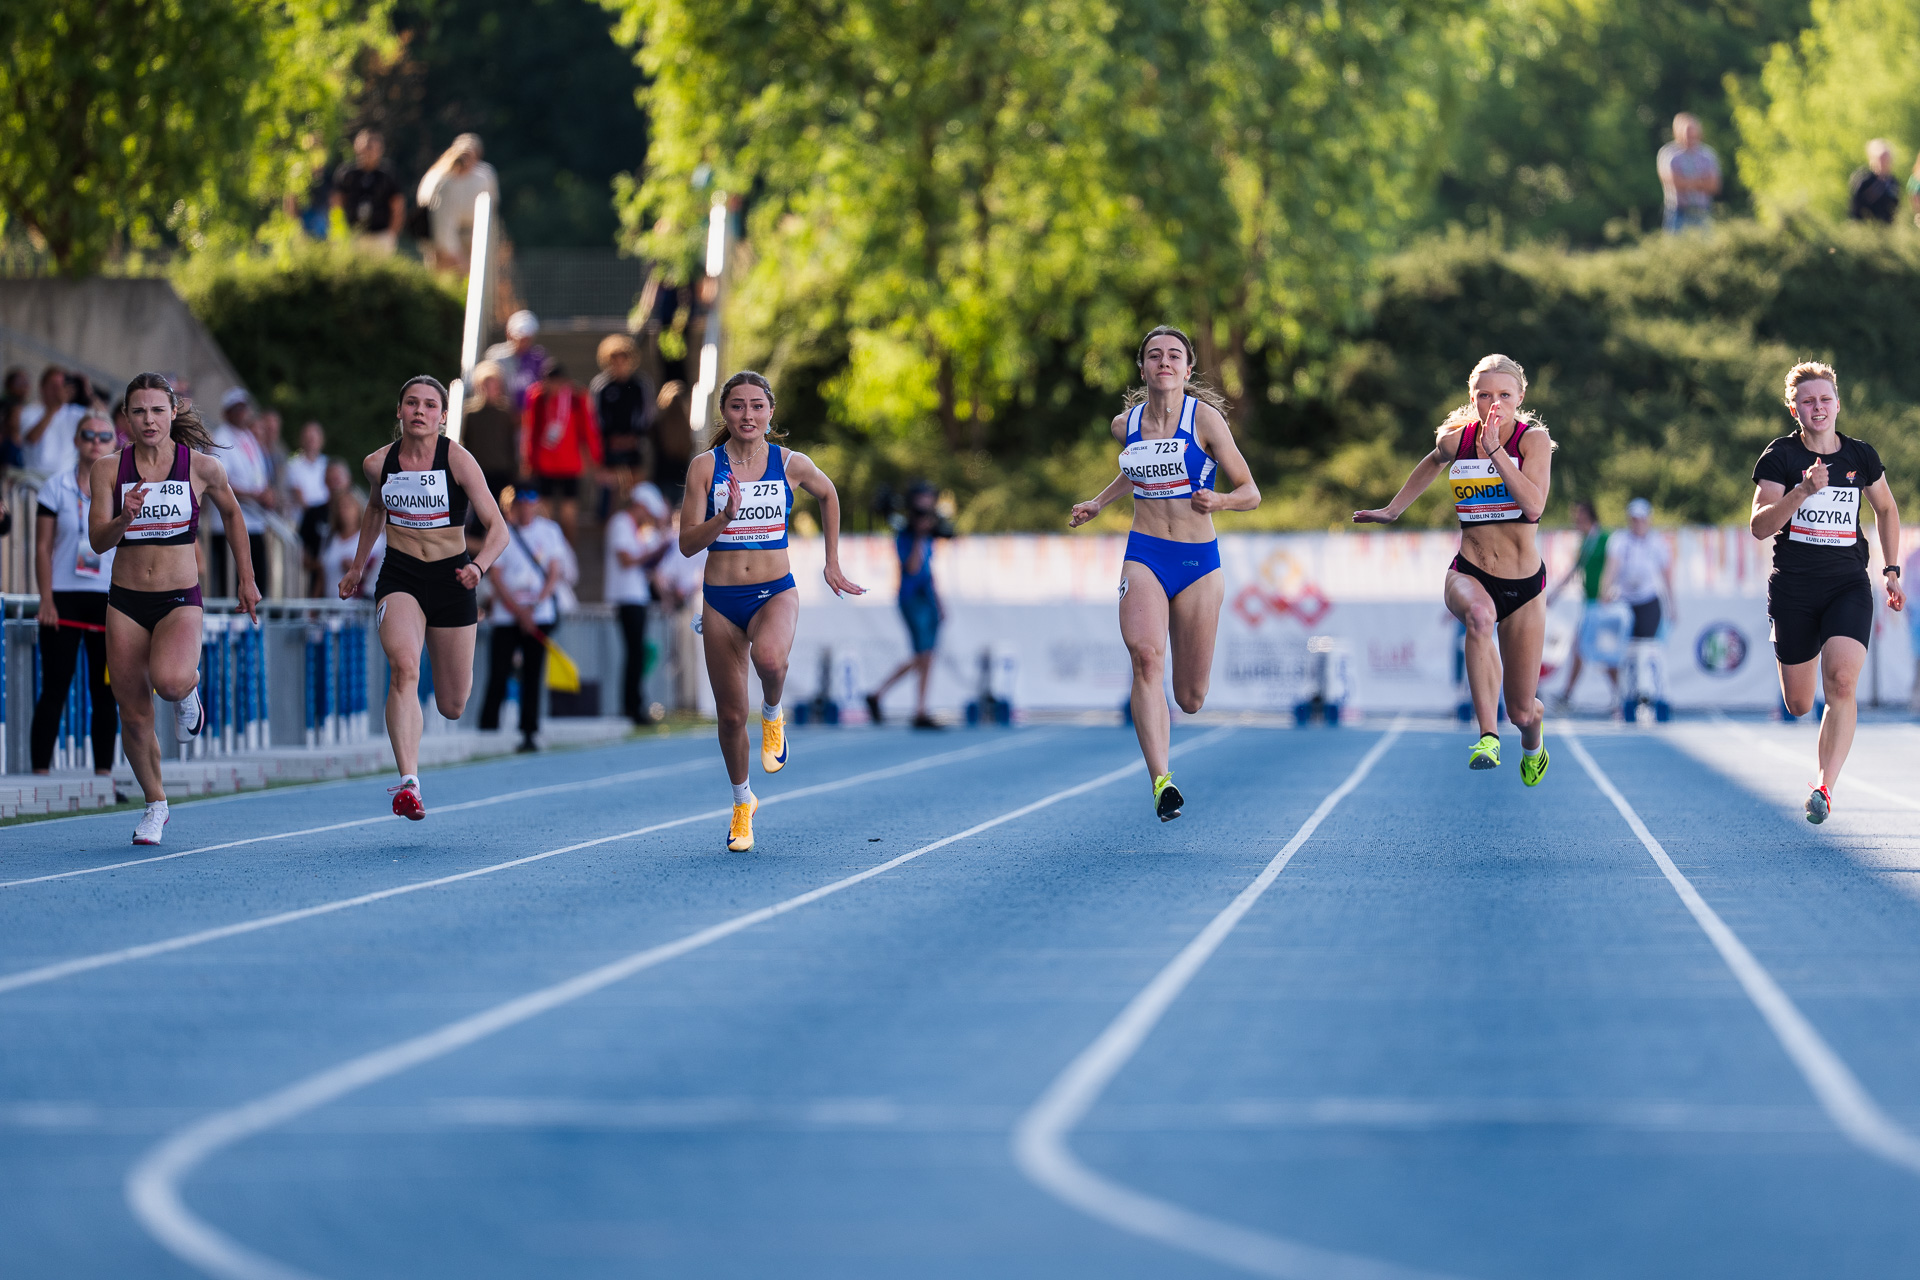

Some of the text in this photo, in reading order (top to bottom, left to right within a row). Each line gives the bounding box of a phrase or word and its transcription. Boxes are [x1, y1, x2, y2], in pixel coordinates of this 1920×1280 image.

[1154, 441, 1179, 455] 723
[1122, 461, 1185, 478] PASIERBEK
[1487, 462, 1500, 475] 6
[420, 474, 436, 486] 58
[159, 483, 184, 496] 488
[753, 483, 779, 497] 275
[384, 494, 446, 508] ROMANIUK
[1832, 490, 1854, 503] 721
[135, 503, 182, 520] RĘDA
[1796, 507, 1852, 525] KOZYRA
[400, 519, 418, 527] LUBLIN
[161, 529, 175, 537] 2026
[1805, 536, 1826, 544] LUBLIN
